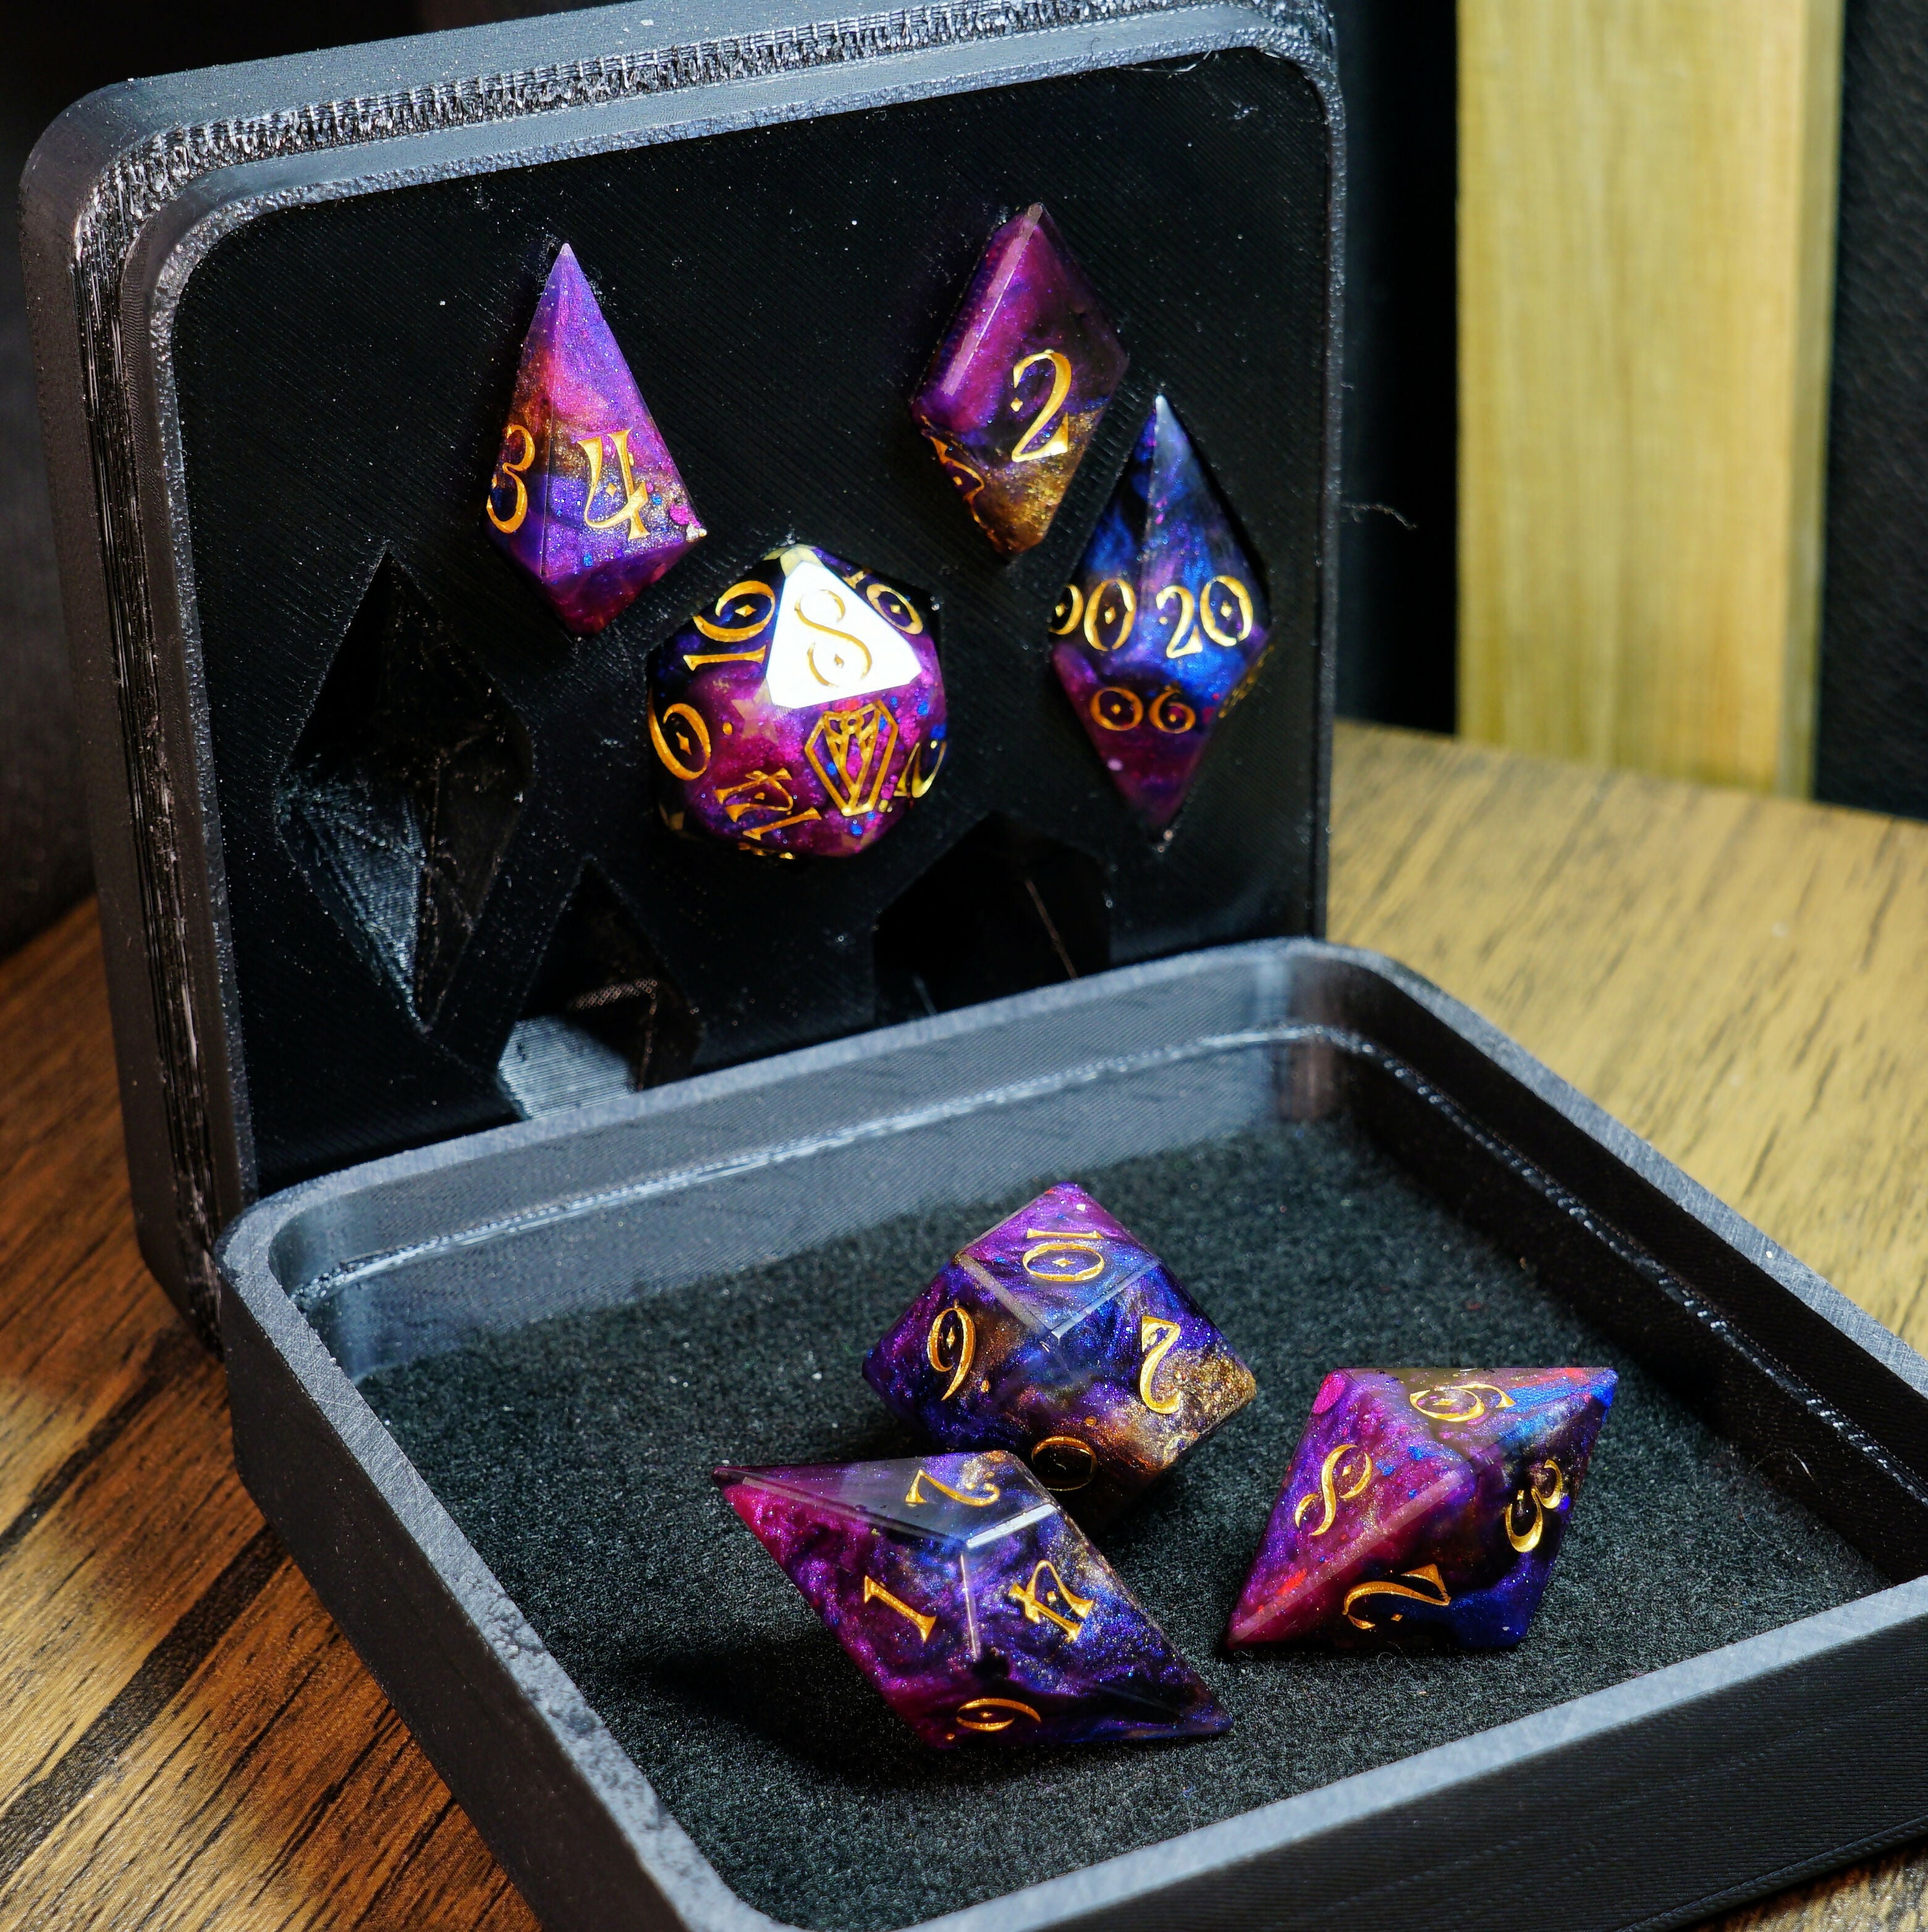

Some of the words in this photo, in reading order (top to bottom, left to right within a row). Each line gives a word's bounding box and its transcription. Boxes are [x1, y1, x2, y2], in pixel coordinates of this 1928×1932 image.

[1010, 348, 1072, 463] 2
[486, 424, 536, 534] 3
[578, 428, 653, 541] 4
[794, 588, 873, 688] 8
[1156, 575, 1254, 659] 20
[1022, 1226, 1105, 1283] 10
[927, 1302, 976, 1401] 9
[1295, 1443, 1374, 1537] 8
[1505, 1459, 1563, 1554] 3
[864, 1574, 937, 1644] 1
